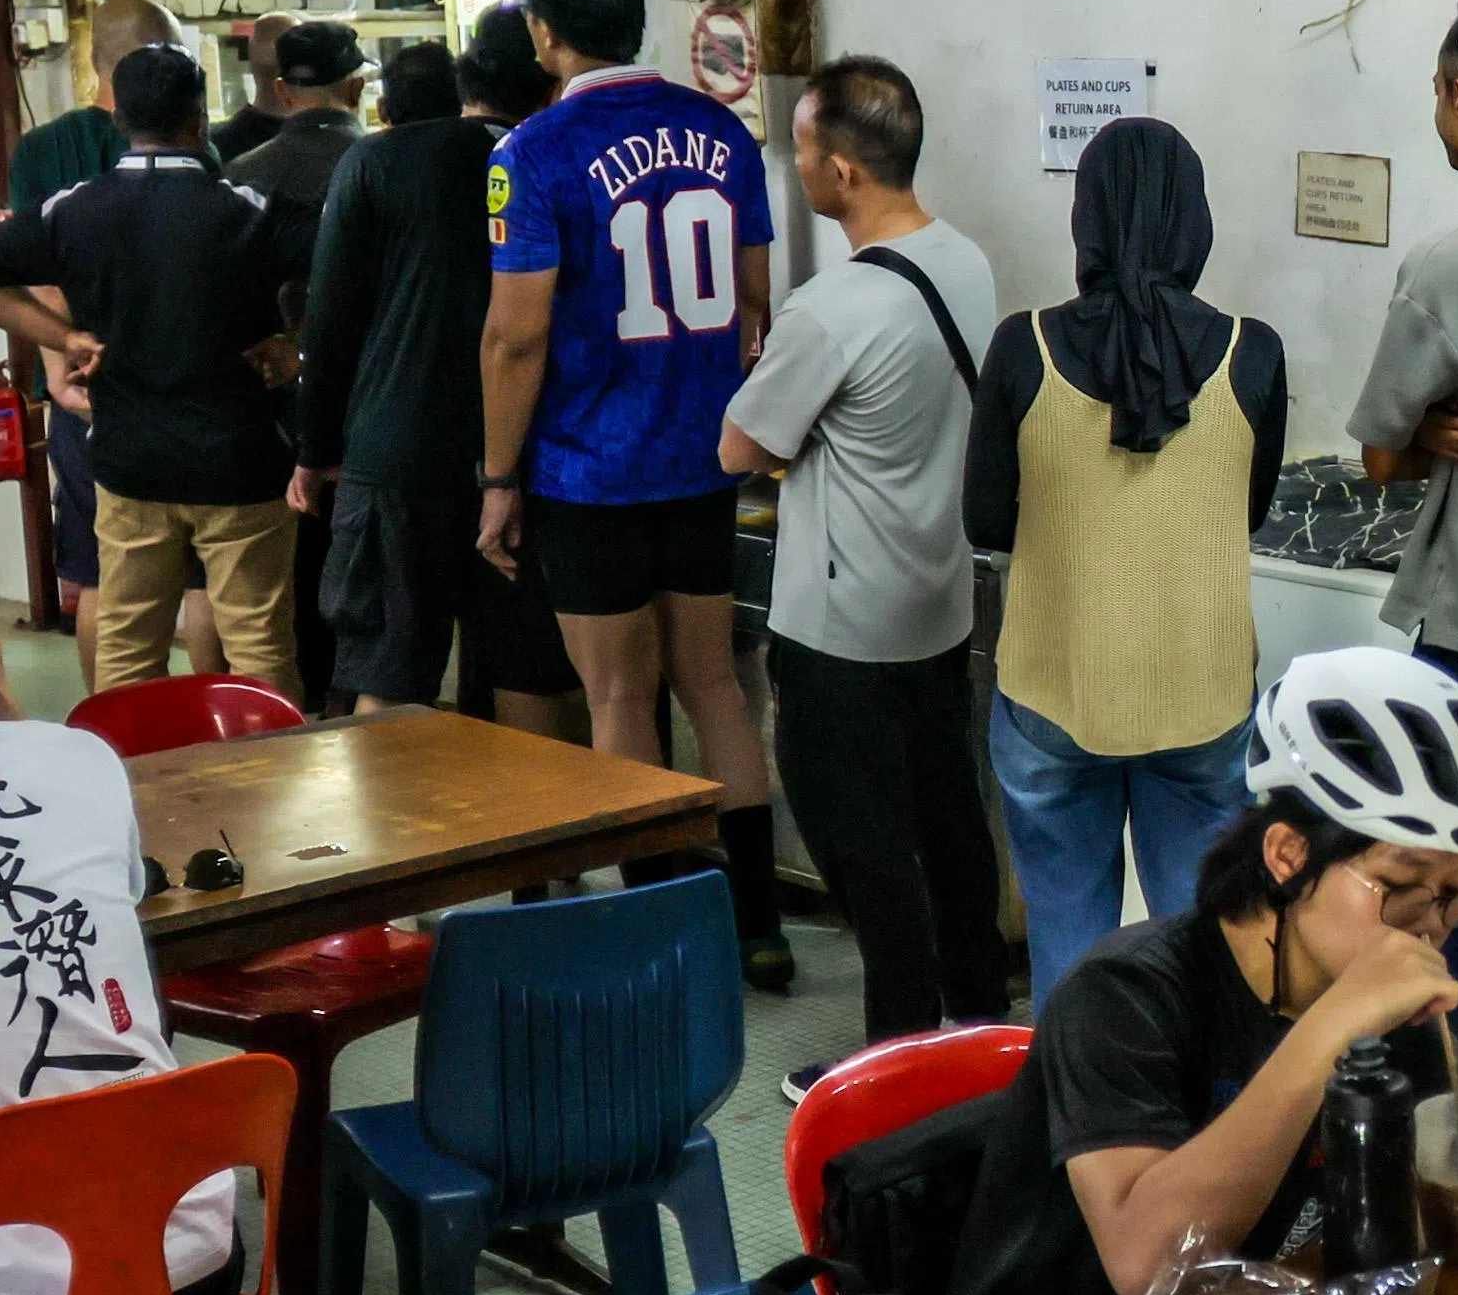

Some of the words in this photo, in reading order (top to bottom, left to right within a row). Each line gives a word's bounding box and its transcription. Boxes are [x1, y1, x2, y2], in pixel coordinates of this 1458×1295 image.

[1046, 79, 1079, 92] PLATES
[1081, 80, 1103, 92] AND
[1105, 80, 1131, 93] CUPS
[1055, 103, 1093, 115] RETURN
[1095, 104, 1122, 116] AREA
[588, 127, 730, 200] ZIDANE
[1329, 191, 1363, 203] RETURN
[609, 188, 736, 341] 10
[1275, 1197, 1323, 1259] adida
